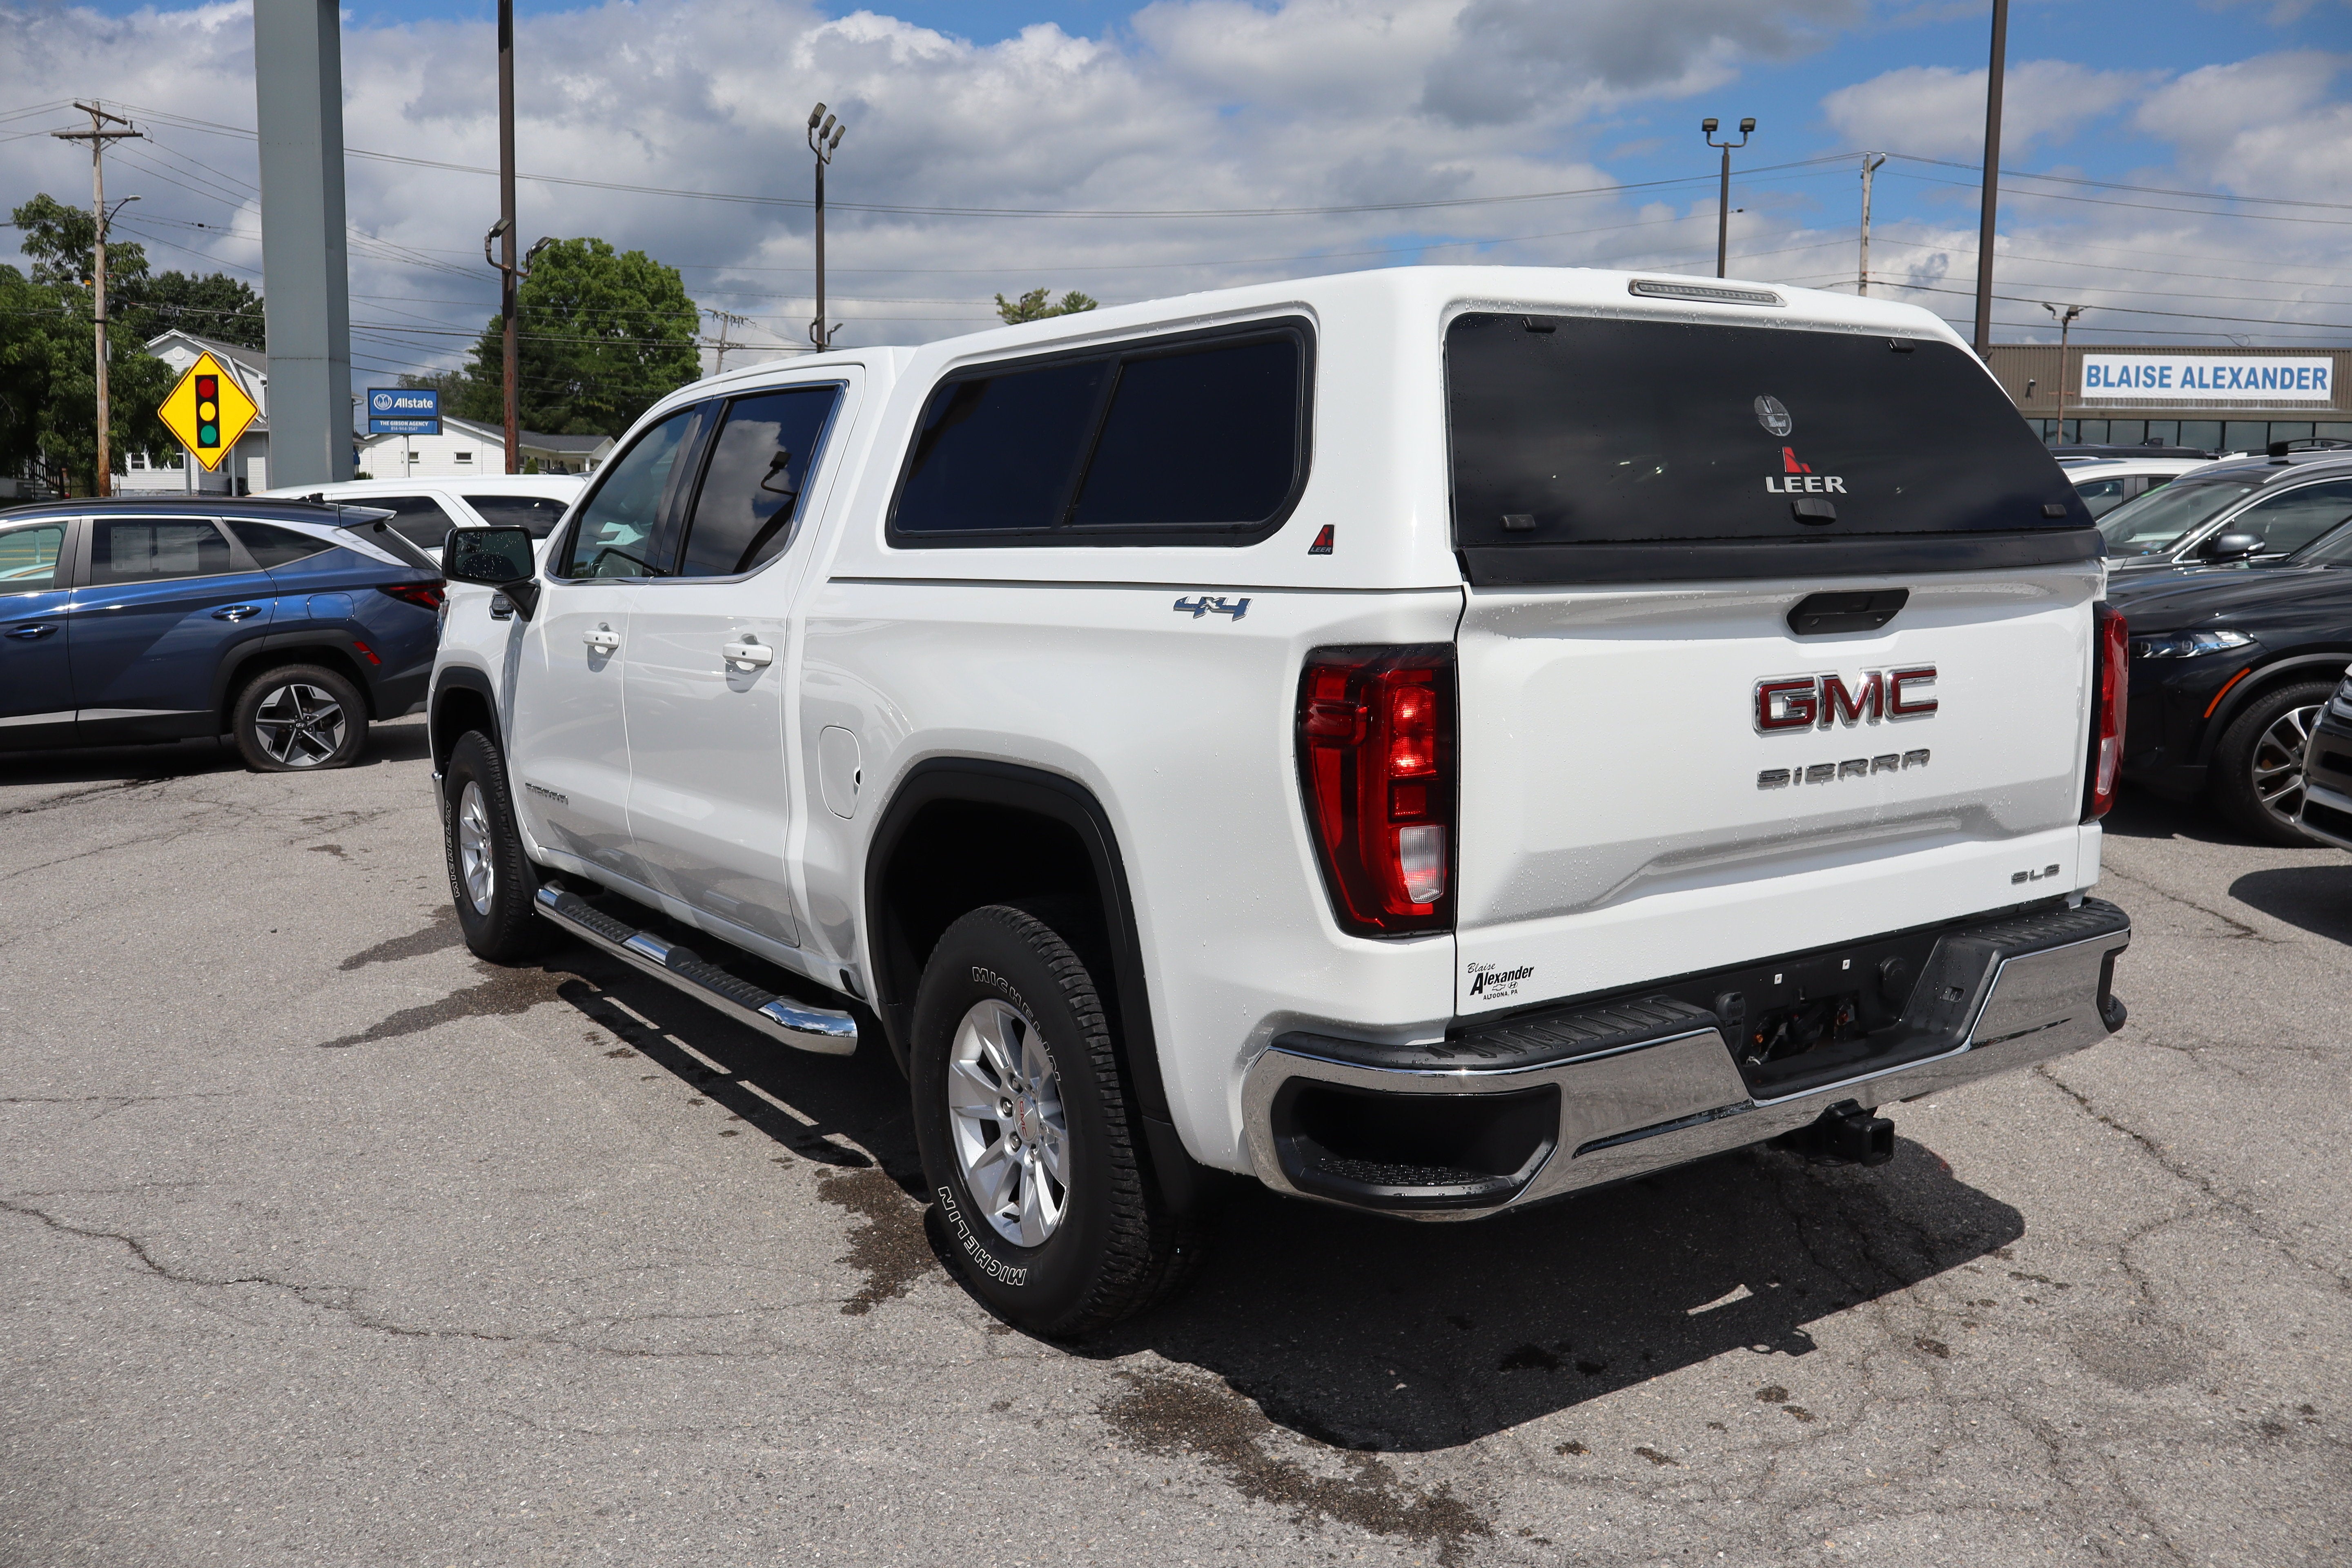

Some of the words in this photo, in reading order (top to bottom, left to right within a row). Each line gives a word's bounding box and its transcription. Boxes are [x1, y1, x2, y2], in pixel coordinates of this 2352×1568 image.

[2086, 365, 2172, 388] BLAISE
[2180, 365, 2328, 390] ALEXANDER
[394, 398, 433, 408] Allstate
[1765, 476, 1848, 494] LEER
[1752, 665, 1939, 734] GMC
[1757, 748, 1930, 788] SIERRA
[445, 800, 460, 898] MICHELIN
[2011, 864, 2060, 884] SLE
[1467, 962, 1496, 973] Blaise
[1469, 965, 1535, 996] Alexander
[1020, 1101, 1028, 1137] GMC
[938, 1186, 1027, 1286] MICHELIN
